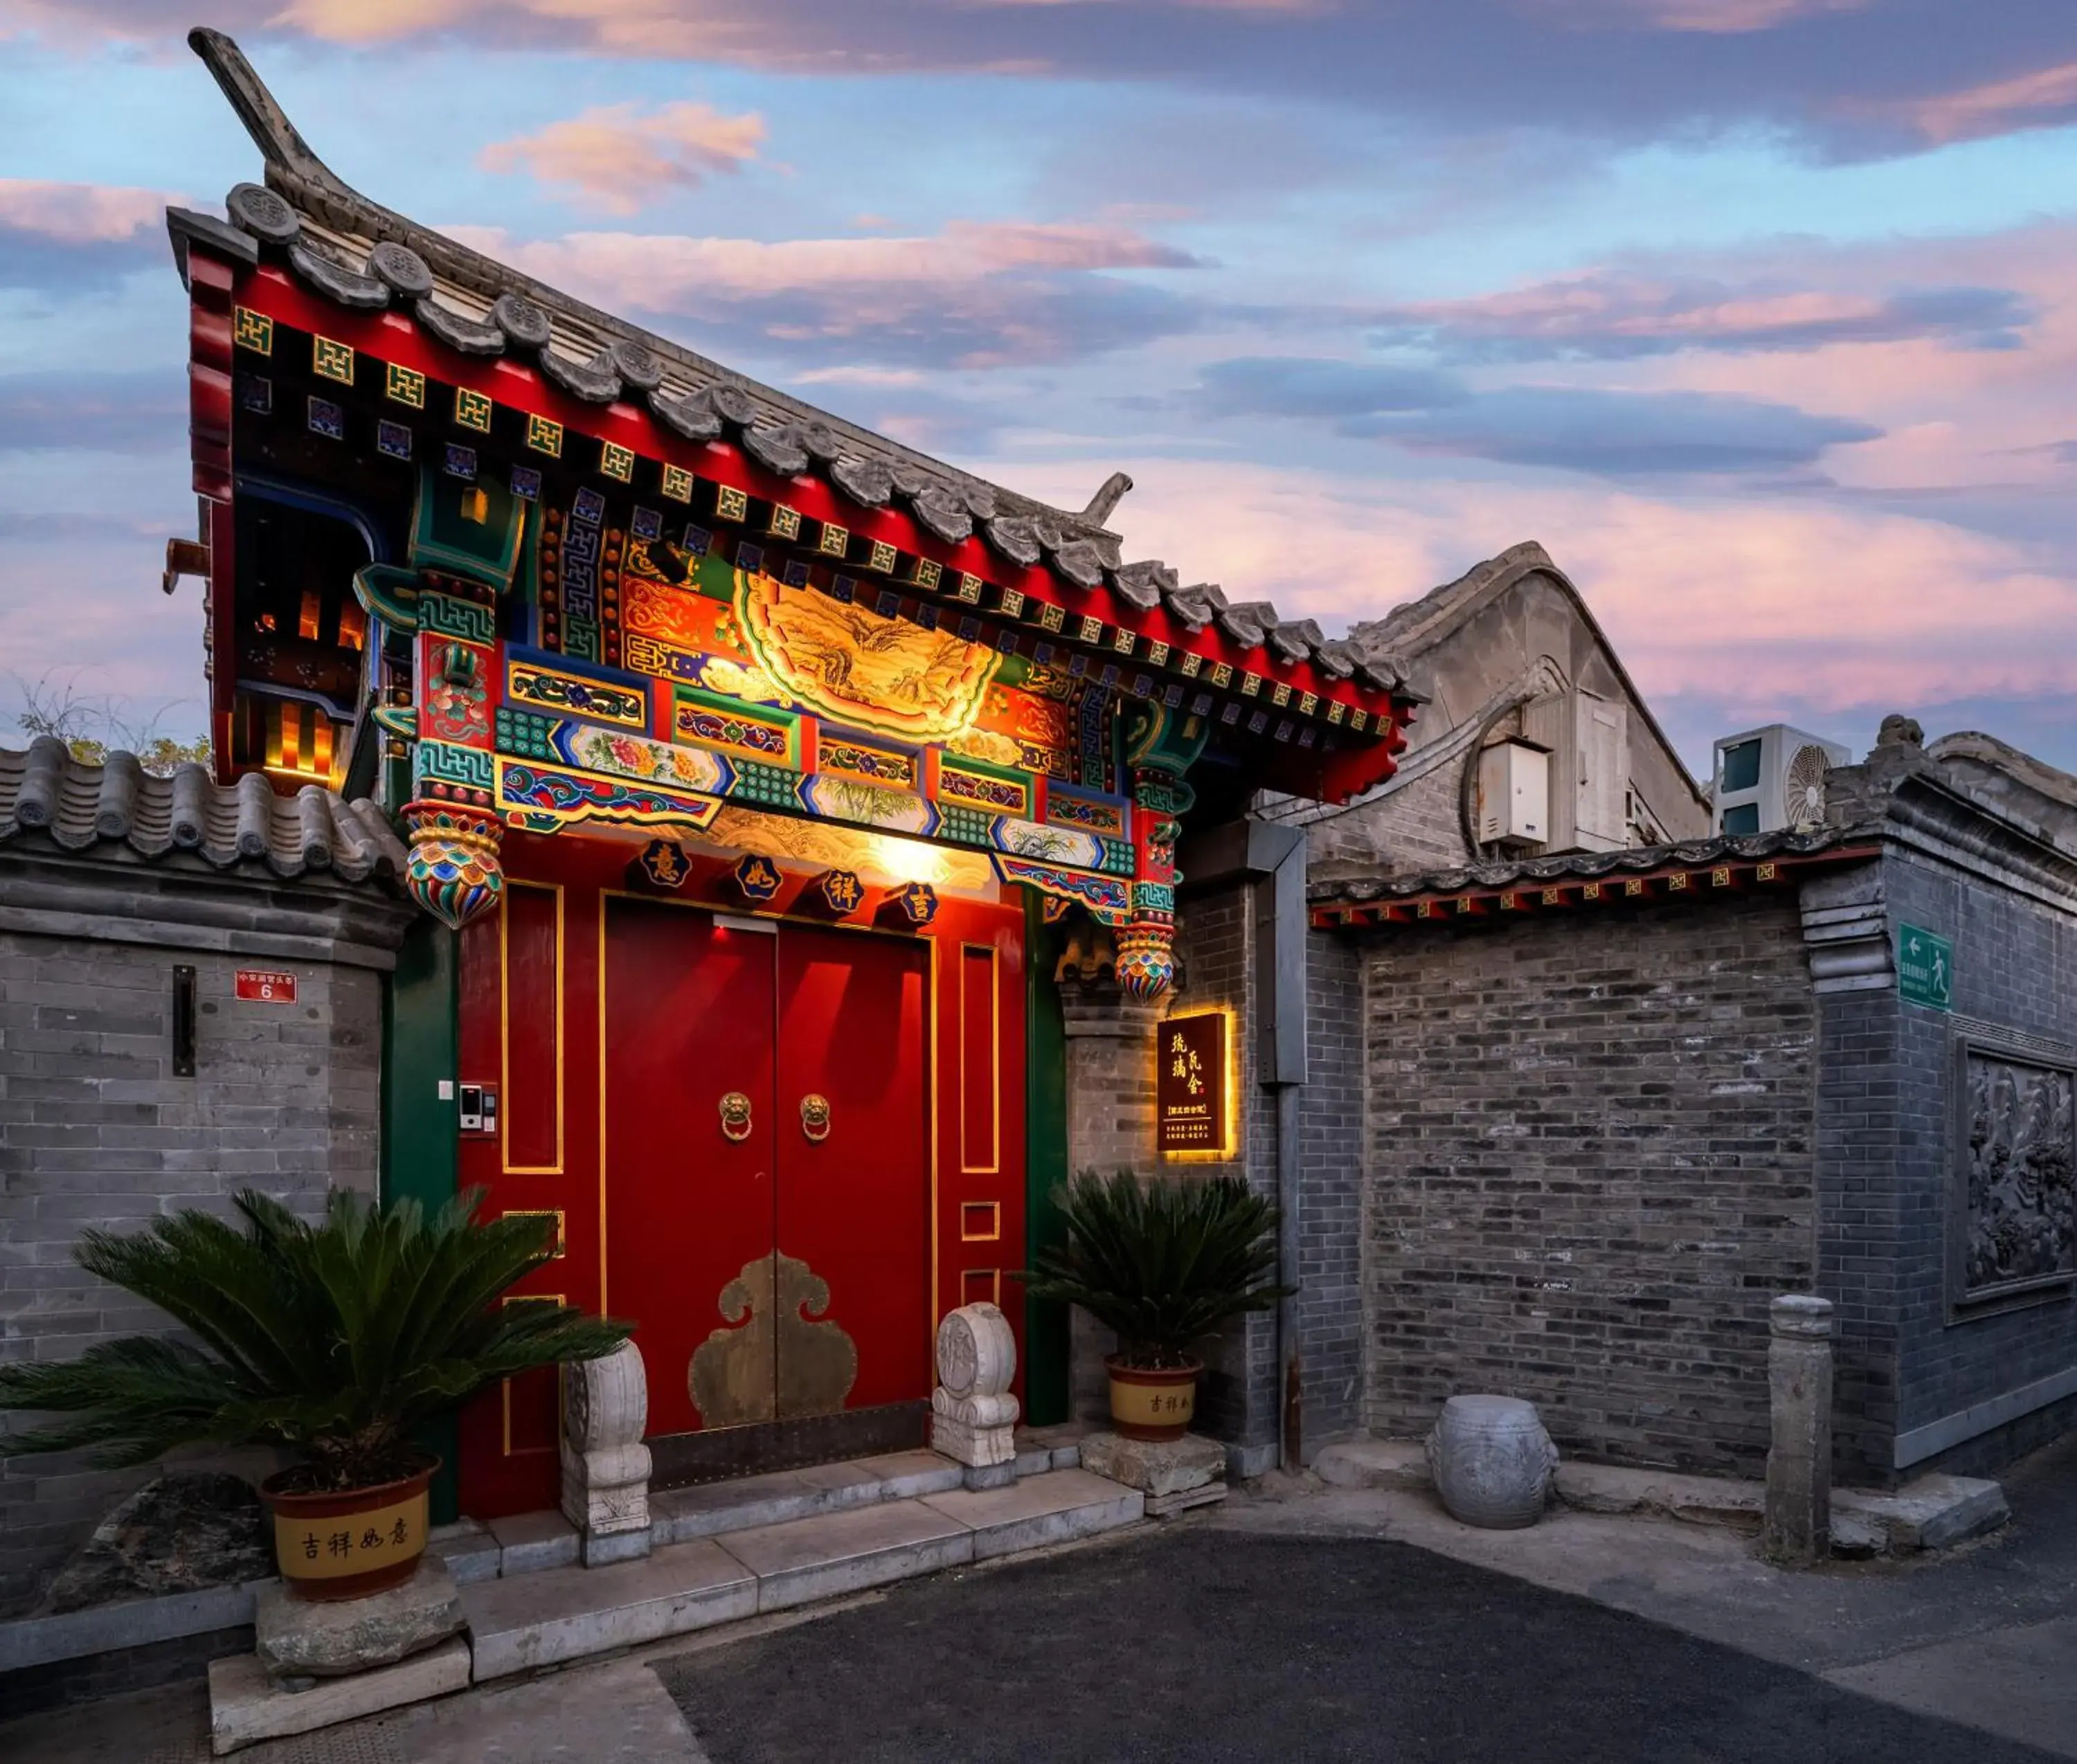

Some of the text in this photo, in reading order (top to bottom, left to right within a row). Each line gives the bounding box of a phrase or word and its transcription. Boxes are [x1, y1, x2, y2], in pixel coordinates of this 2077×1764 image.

[649, 843, 933, 919] 吉 祥 如 意
[262, 984, 272, 998] 6
[300, 1517, 409, 1559] 吉祥如意
